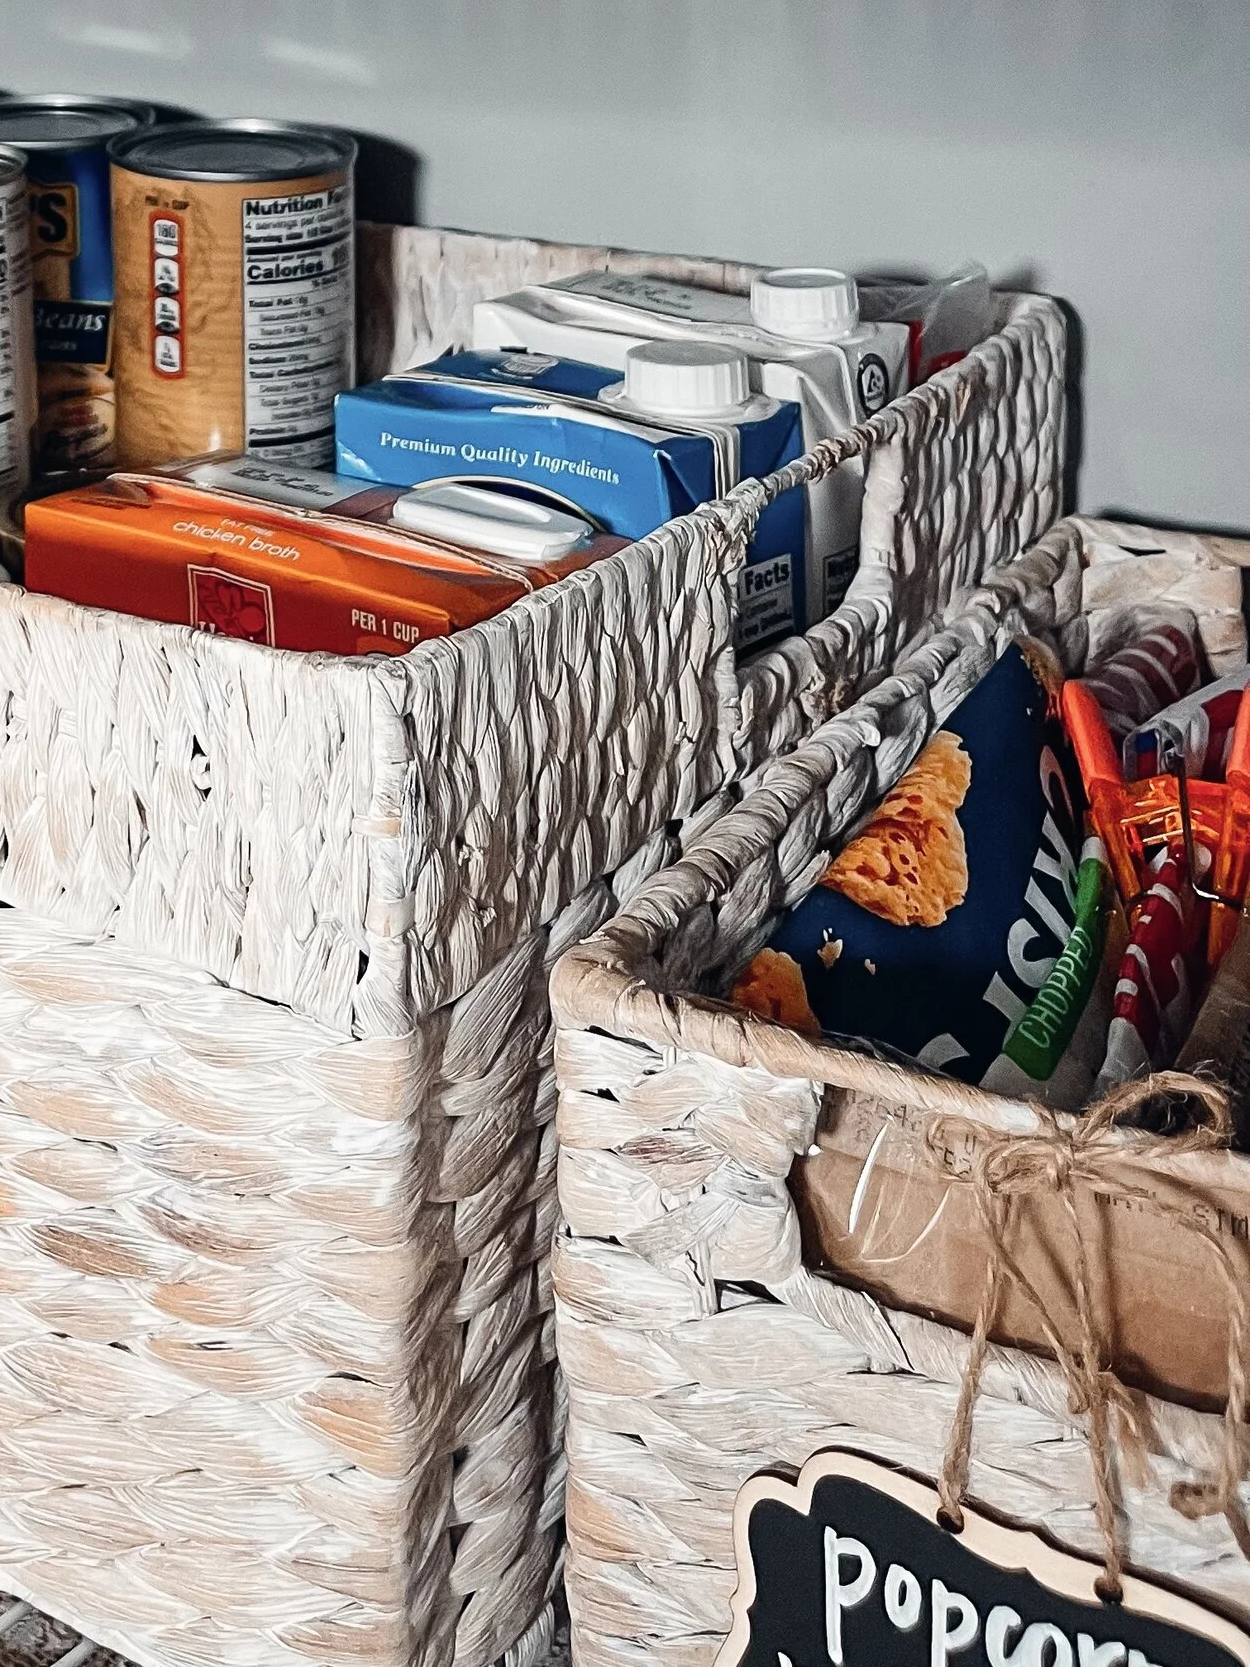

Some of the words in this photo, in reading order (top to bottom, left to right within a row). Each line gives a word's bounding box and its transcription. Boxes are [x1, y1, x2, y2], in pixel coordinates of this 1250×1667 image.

[246, 195, 323, 216] Nutrition
[246, 260, 324, 280] Calories
[379, 431, 457, 457] Premium
[460, 442, 529, 469] Quality
[533, 450, 621, 486] Ingredients
[172, 521, 247, 546] chicken
[248, 536, 301, 562] broth
[744, 562, 790, 595] Facts
[351, 608, 377, 632] PER
[381, 618, 387, 636] 1
[393, 621, 420, 644] CUP
[1018, 924, 1093, 1050] CHOPPED
[824, 1525, 1164, 1667] popcor
